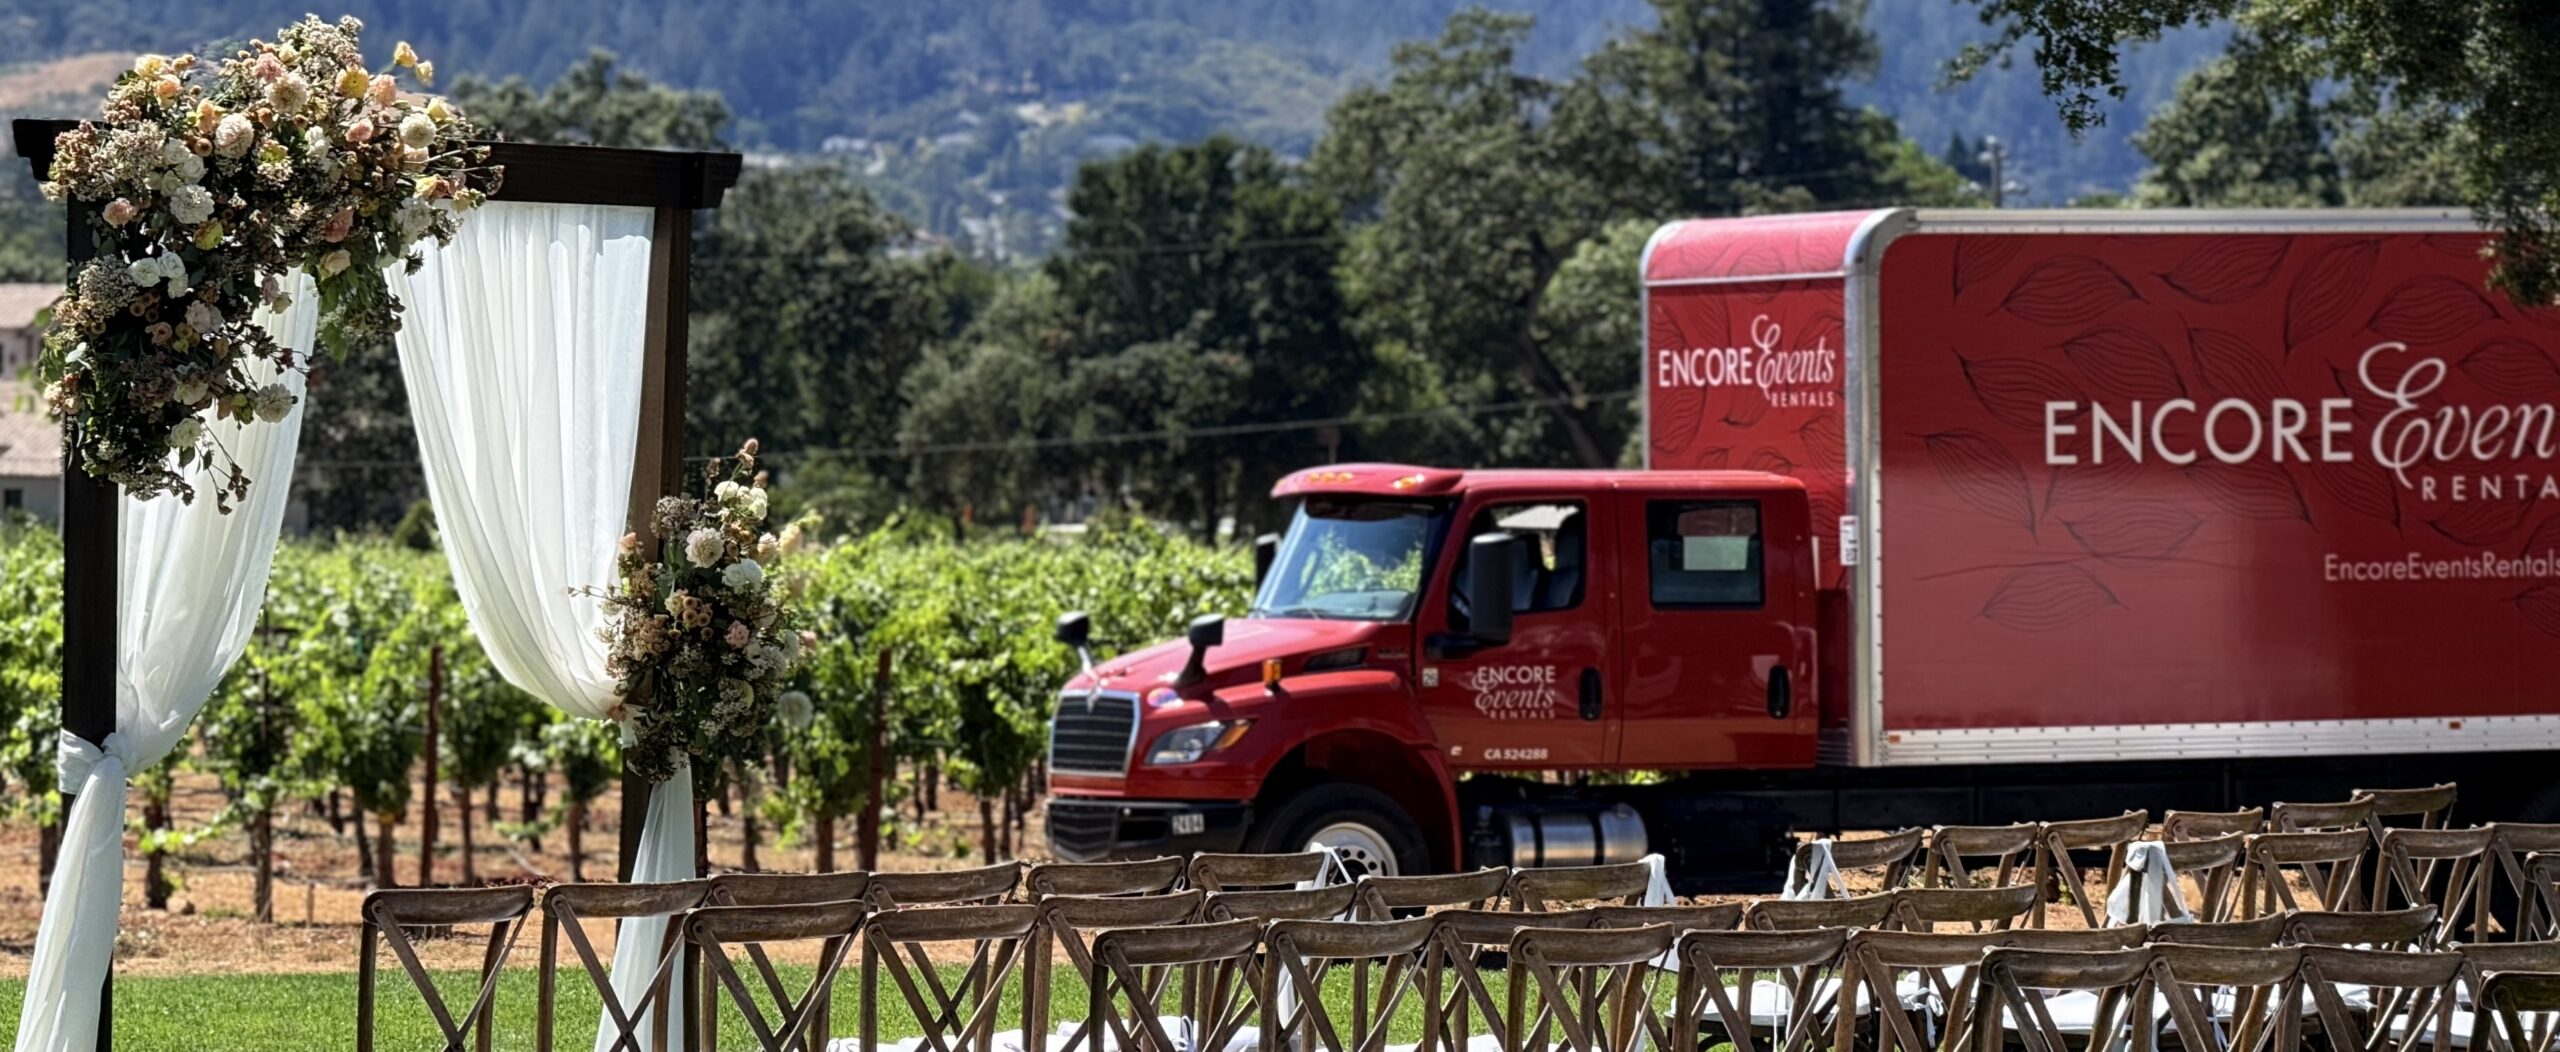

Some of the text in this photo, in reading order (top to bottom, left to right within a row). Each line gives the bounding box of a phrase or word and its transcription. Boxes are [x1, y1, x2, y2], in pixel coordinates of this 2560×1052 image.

[1658, 314, 1836, 400] ENCORE Events
[1771, 391, 1836, 407] RENTALS
[2045, 397, 2354, 464] ENCORE
[2422, 474, 2560, 501] RENTA
[1477, 666, 1557, 683] ENCORE
[1471, 672, 1557, 715] Events
[1489, 709, 1556, 719] RENTALS
[1484, 748, 1502, 760] CA
